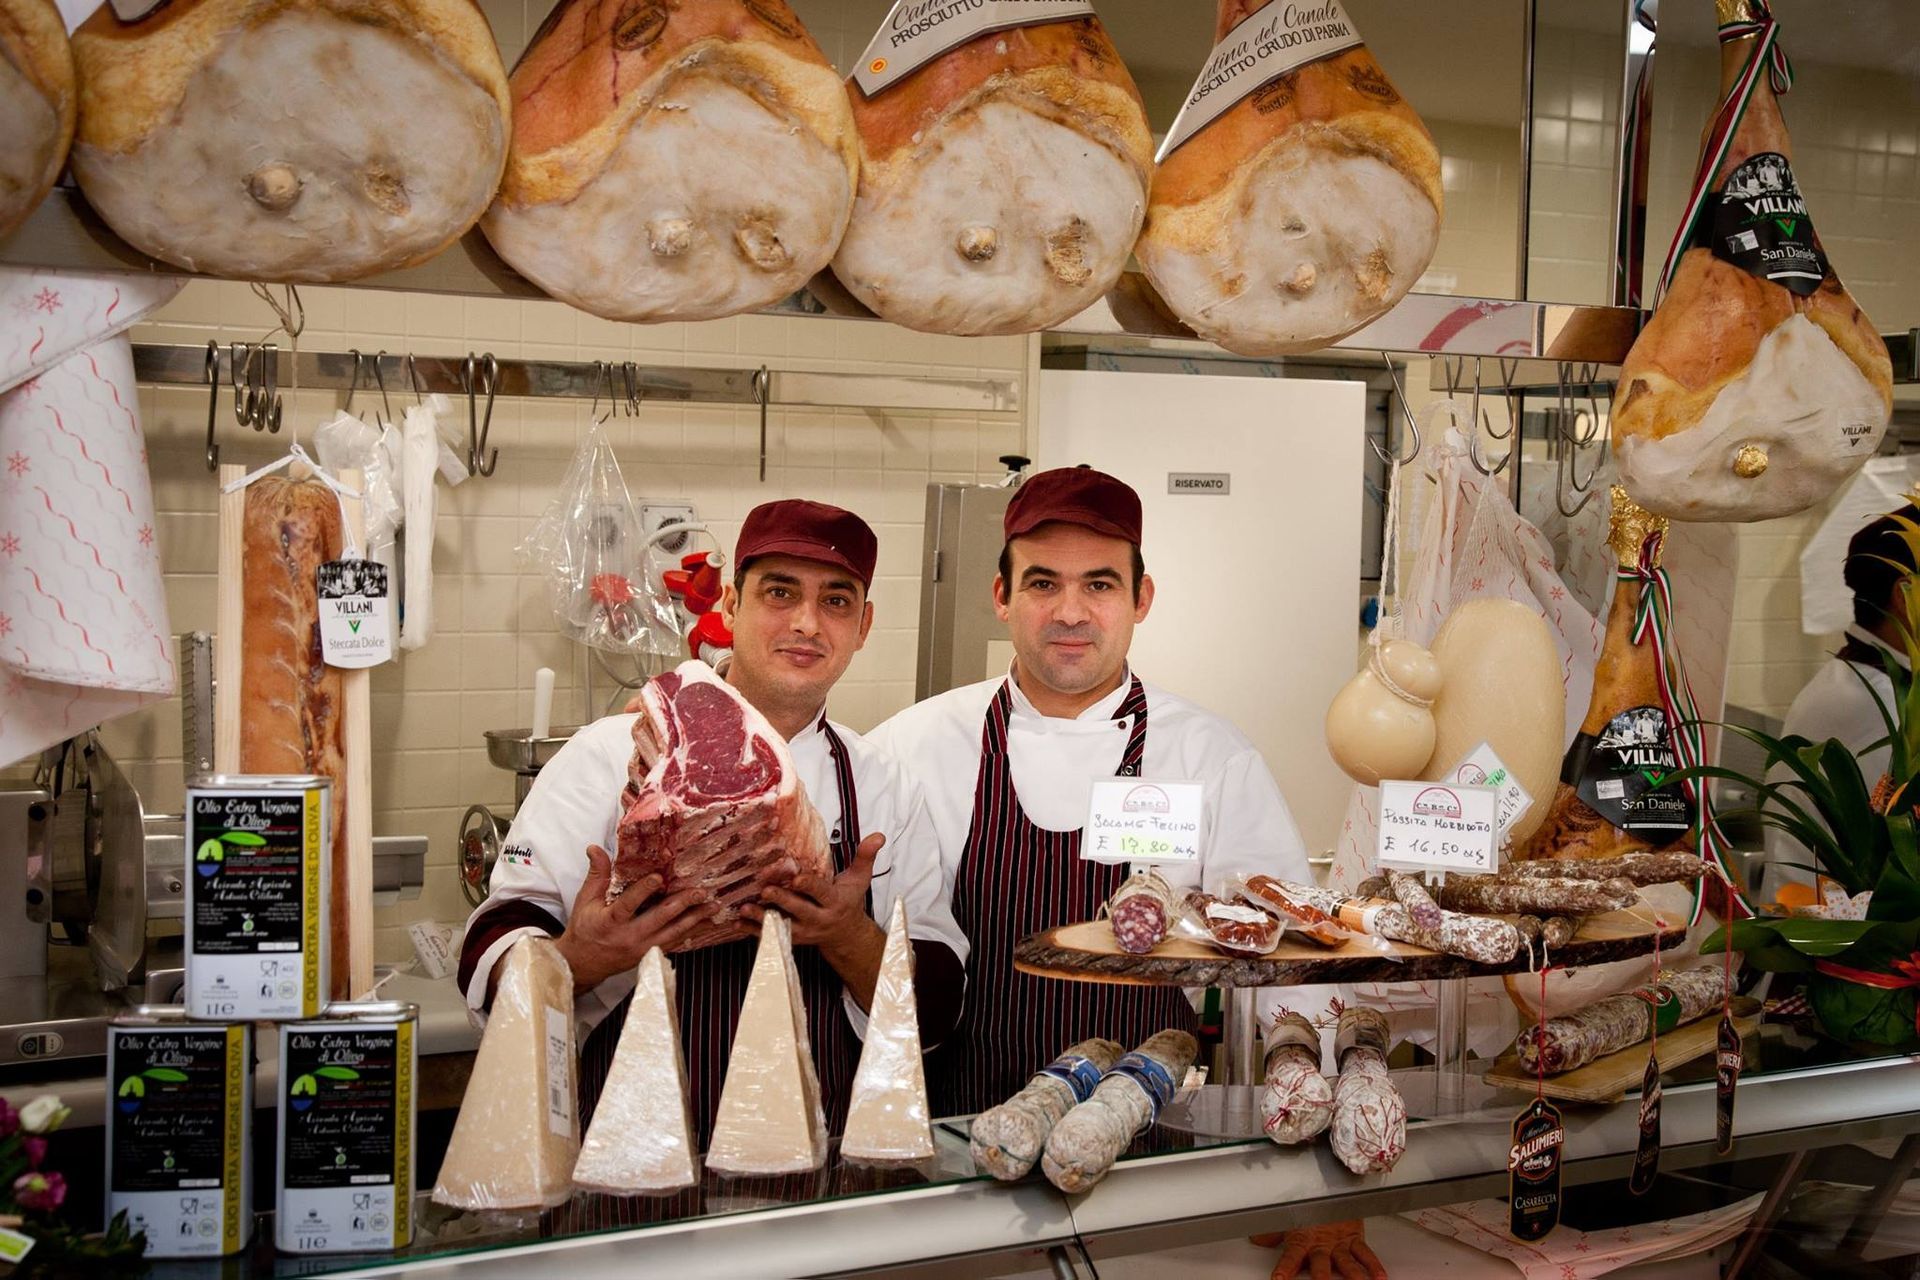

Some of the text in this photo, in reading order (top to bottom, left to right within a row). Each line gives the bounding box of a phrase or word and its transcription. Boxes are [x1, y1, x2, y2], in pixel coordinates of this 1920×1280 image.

[889, 0, 983, 48] PROSCIUTTO
[1254, 17, 1279, 46] del
[1284, 4, 1339, 29] Canale
[1187, 55, 1256, 110] OSCIUTTO
[1257, 30, 1302, 60] CRUDO
[1302, 28, 1315, 44] DI
[1316, 22, 1350, 43] PARMA
[1761, 246, 1816, 261] San Daniele
[1842, 426, 1872, 436] VILLANI
[1175, 479, 1223, 488] RISERVATO
[335, 601, 373, 614] VILLANI
[329, 636, 385, 650] Steccata Dolce
[1618, 749, 1676, 768] VILLANI
[197, 799, 300, 816] Olio Extra Vergine
[1621, 798, 1686, 811] San Daniele
[223, 813, 271, 828] di Oliva
[307, 804, 319, 1001] OLIO EXTRA VERGINE DI OLIVA
[119, 1035, 223, 1051] Olio Extra Vergine
[291, 1034, 393, 1050] Olio Extra Vergine
[228, 1040, 241, 1237] OLIO EXTRA VERGINE DI OLIVA
[398, 1038, 410, 1232] OLIO EXTRA VERGINE DI OLIVA
[1510, 1128, 1563, 1169] SALUMIERI
[1515, 1194, 1556, 1210] CASARECCIA
